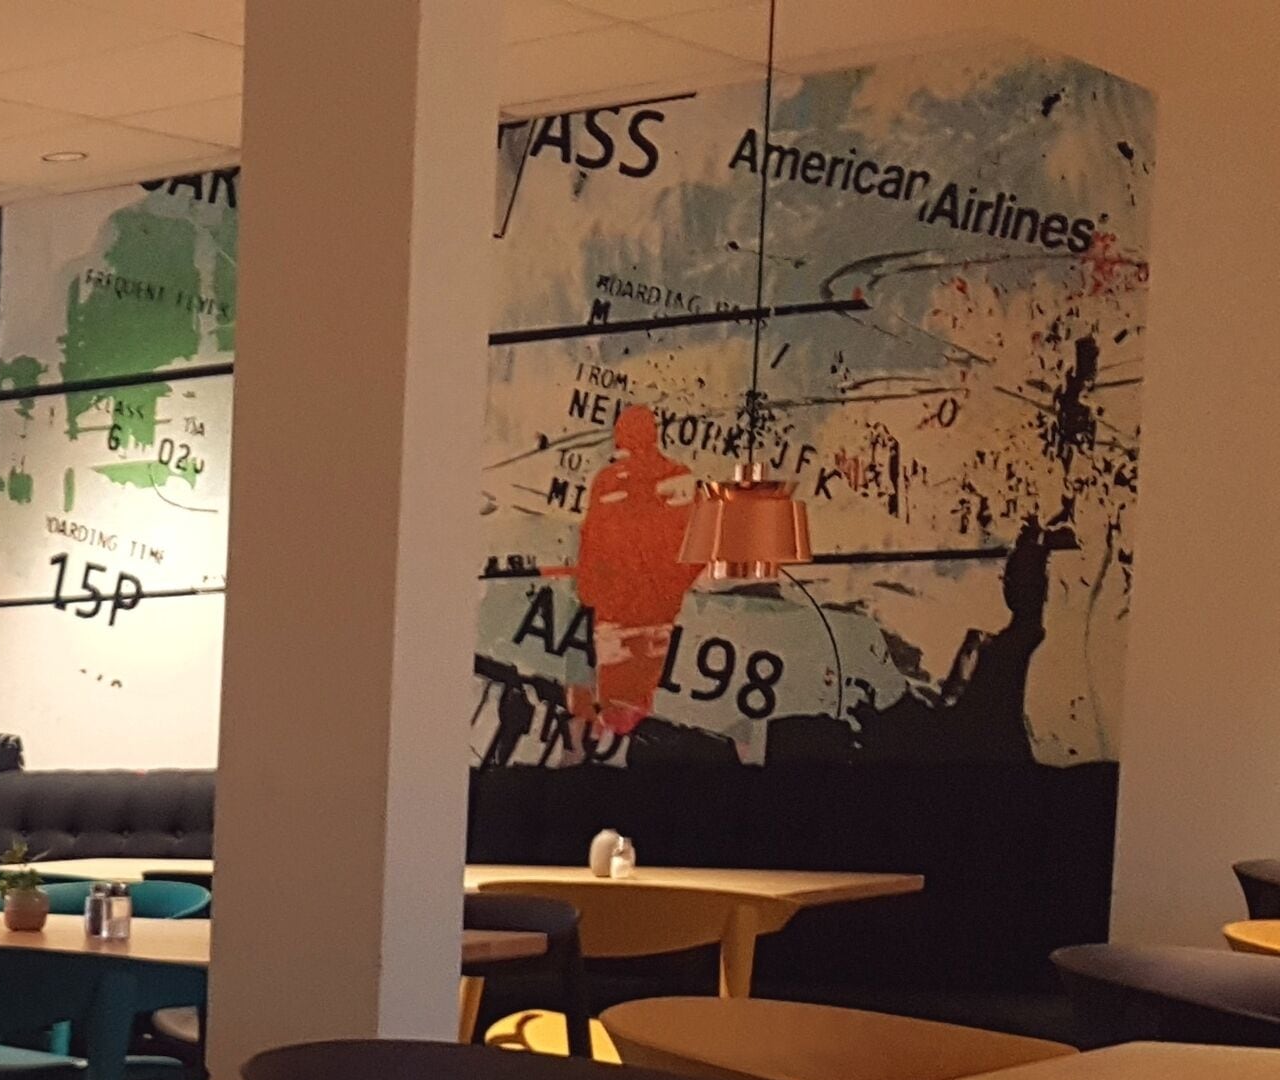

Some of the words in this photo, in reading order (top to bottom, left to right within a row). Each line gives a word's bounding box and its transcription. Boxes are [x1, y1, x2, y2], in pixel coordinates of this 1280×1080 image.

[728, 127, 930, 212] American
[927, 183, 1096, 254] Airlines
[49, 551, 145, 627] 15P
